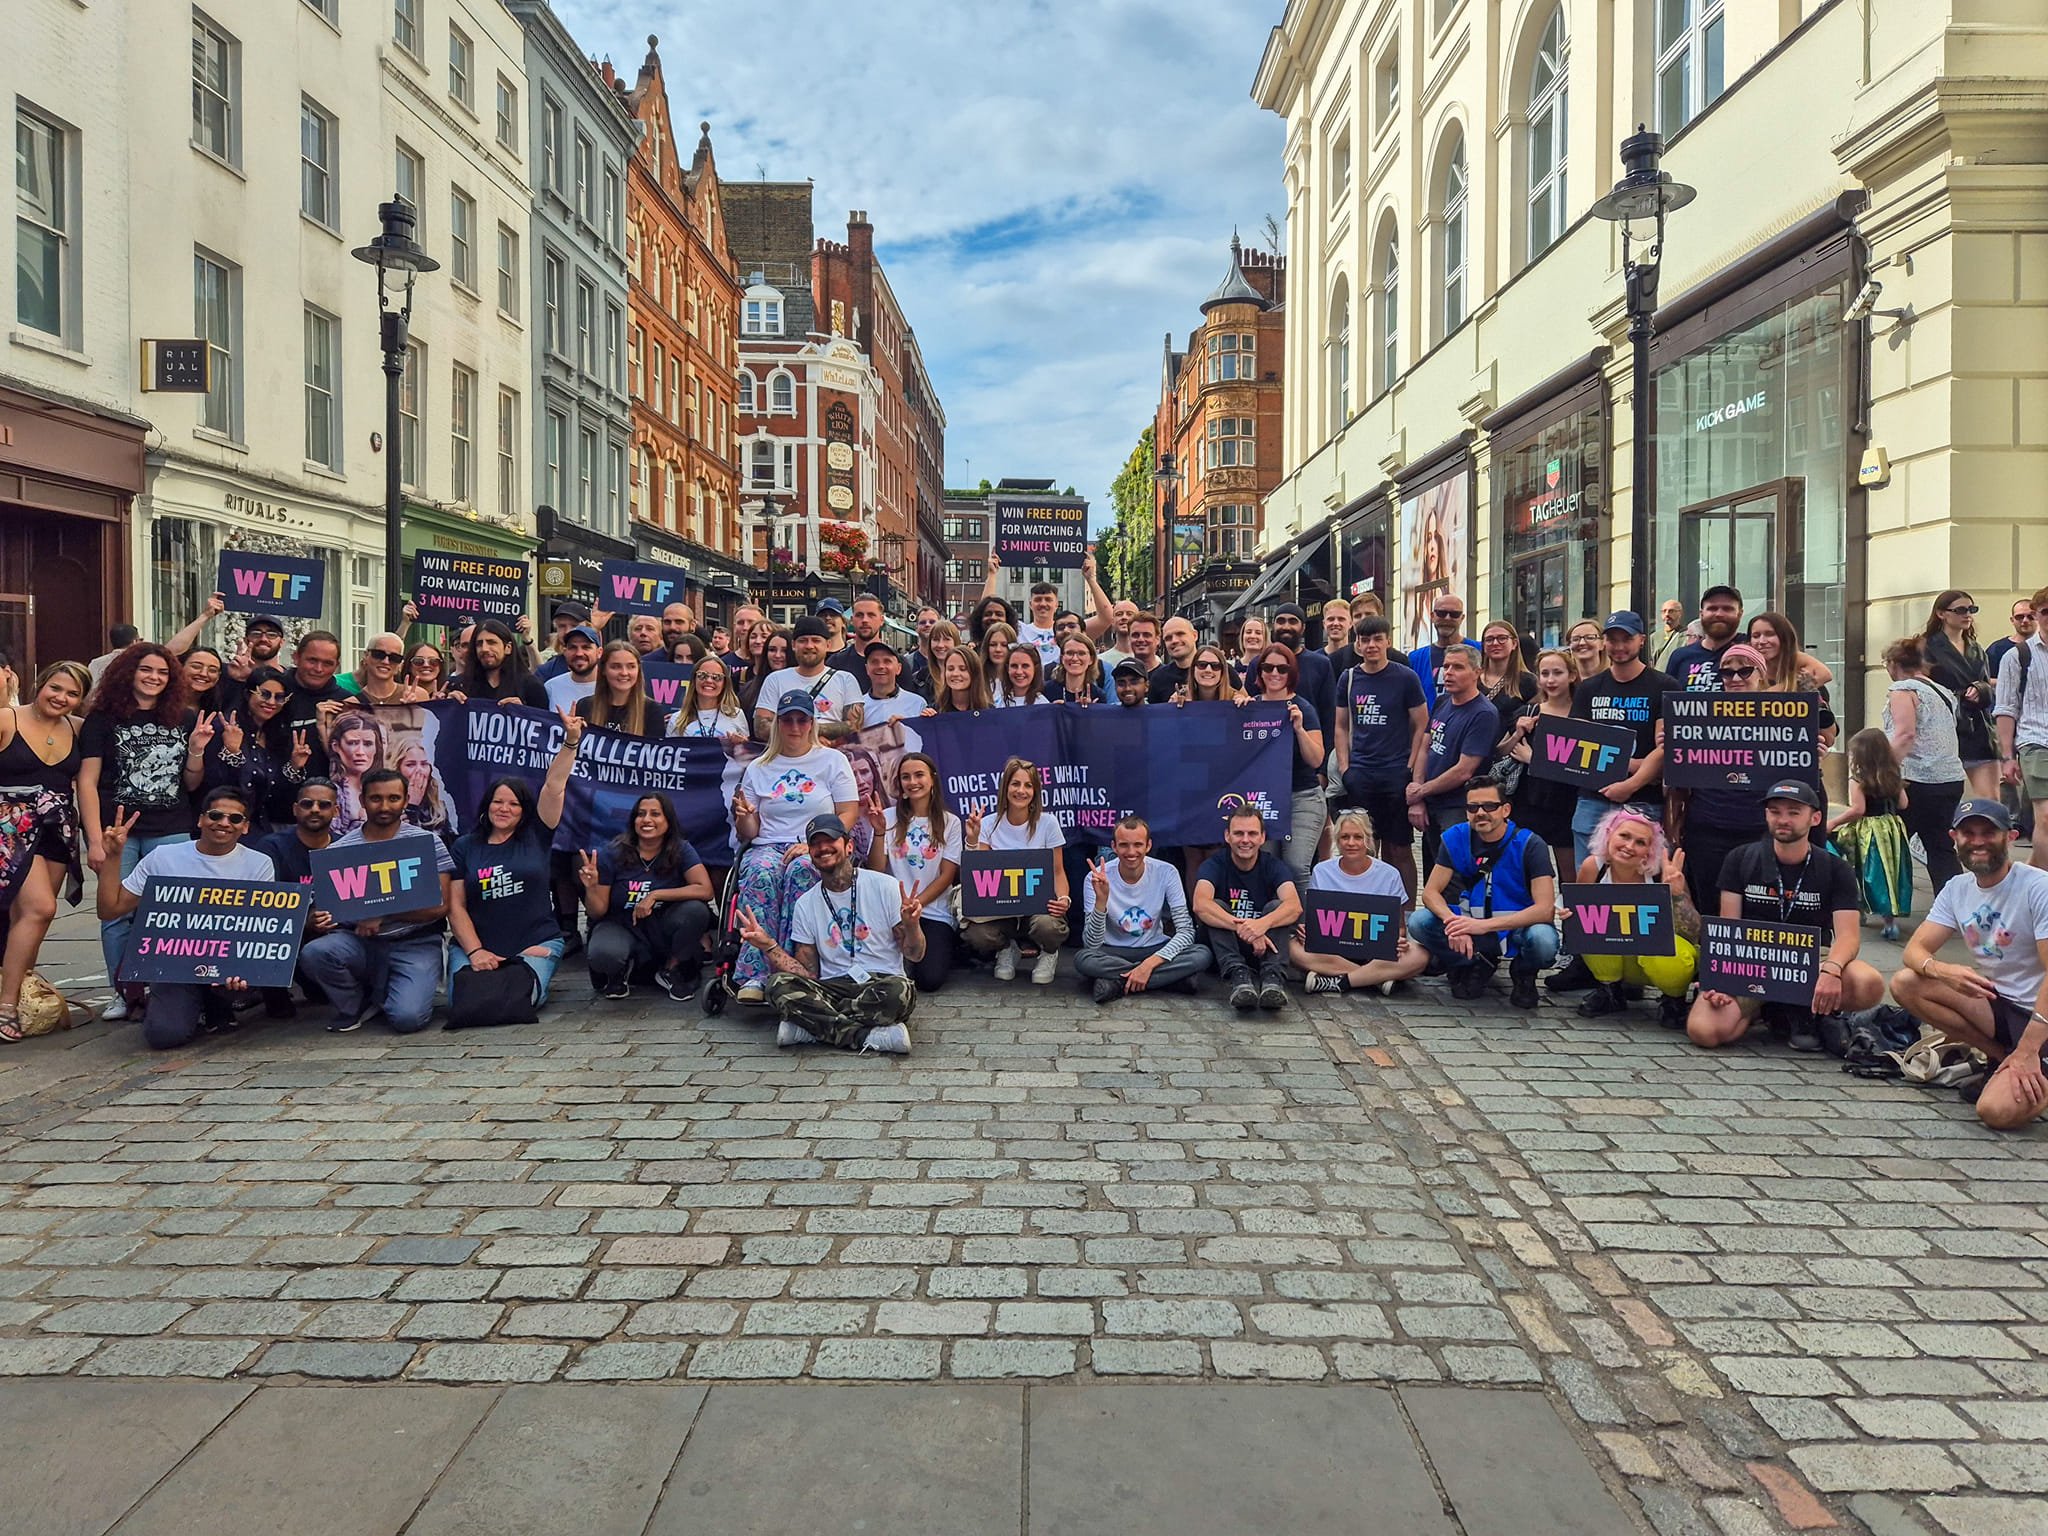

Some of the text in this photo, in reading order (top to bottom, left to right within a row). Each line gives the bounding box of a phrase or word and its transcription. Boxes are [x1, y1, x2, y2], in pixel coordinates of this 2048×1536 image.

[828, 412, 852, 424] WHITE
[1696, 391, 1766, 432] KICK GAME
[831, 421, 849, 430] LION
[1001, 507, 1083, 521] WIN FREE FOOD
[1001, 524, 1082, 537] FOR WATCHING A
[1001, 540, 1084, 553] 3 MINUTE VIDEO
[422, 556, 521, 579] WIN FREE FOOD
[651, 546, 691, 570] SKECHERS
[233, 568, 311, 600] WTF
[420, 575, 520, 597] FOR WATCHING A
[612, 575, 674, 603] WTF
[748, 588, 805, 598] WHIE LION
[419, 593, 521, 615] 3 MINUTE VIDEO
[1689, 661, 1714, 674] WE
[1687, 672, 1718, 686] THE
[1356, 695, 1376, 705] WE
[1592, 697, 1610, 707] OUR
[1673, 701, 1808, 718] WIN FREE FOOD
[1356, 705, 1381, 715] THE
[1592, 709, 1649, 722] THEIRS TOO!
[1357, 715, 1387, 725] FREE
[468, 711, 691, 774] MOVIE CALLENGE
[1673, 725, 1809, 742] FOR WATCHING A
[1546, 733, 1620, 772] WTF
[1673, 748, 1812, 767] 3 MINUTE VIDEO
[467, 742, 514, 764] WATCH
[517, 750, 526, 767] 3
[597, 763, 625, 784] WIN
[629, 771, 639, 786] A
[643, 771, 685, 791] PRIZE
[949, 774, 988, 793] ONCE
[1054, 766, 1088, 785] WHAT
[959, 795, 998, 815] HAPP
[1247, 792, 1267, 801] WE
[1262, 811, 1279, 820] EE
[329, 857, 421, 900] WTF
[478, 865, 503, 879] WE
[479, 872, 512, 890] THE
[482, 881, 524, 900] FREE
[629, 881, 652, 891] WE
[972, 868, 1043, 898] WTF
[155, 886, 300, 909] WIN FREE FOOD
[1229, 888, 1248, 899] WE
[1231, 899, 1254, 910] THE
[145, 912, 293, 934] FOR WATCHING A
[1316, 909, 1389, 941] WTF
[1576, 905, 1659, 935] WTF
[1707, 923, 1814, 948] WIN A FREE PRIZE
[138, 937, 291, 960] 3 MINUTE VIDEO
[1709, 941, 1810, 966] FOR WATCHING A
[1710, 959, 1808, 984] 3 MINUTE VIDEO
